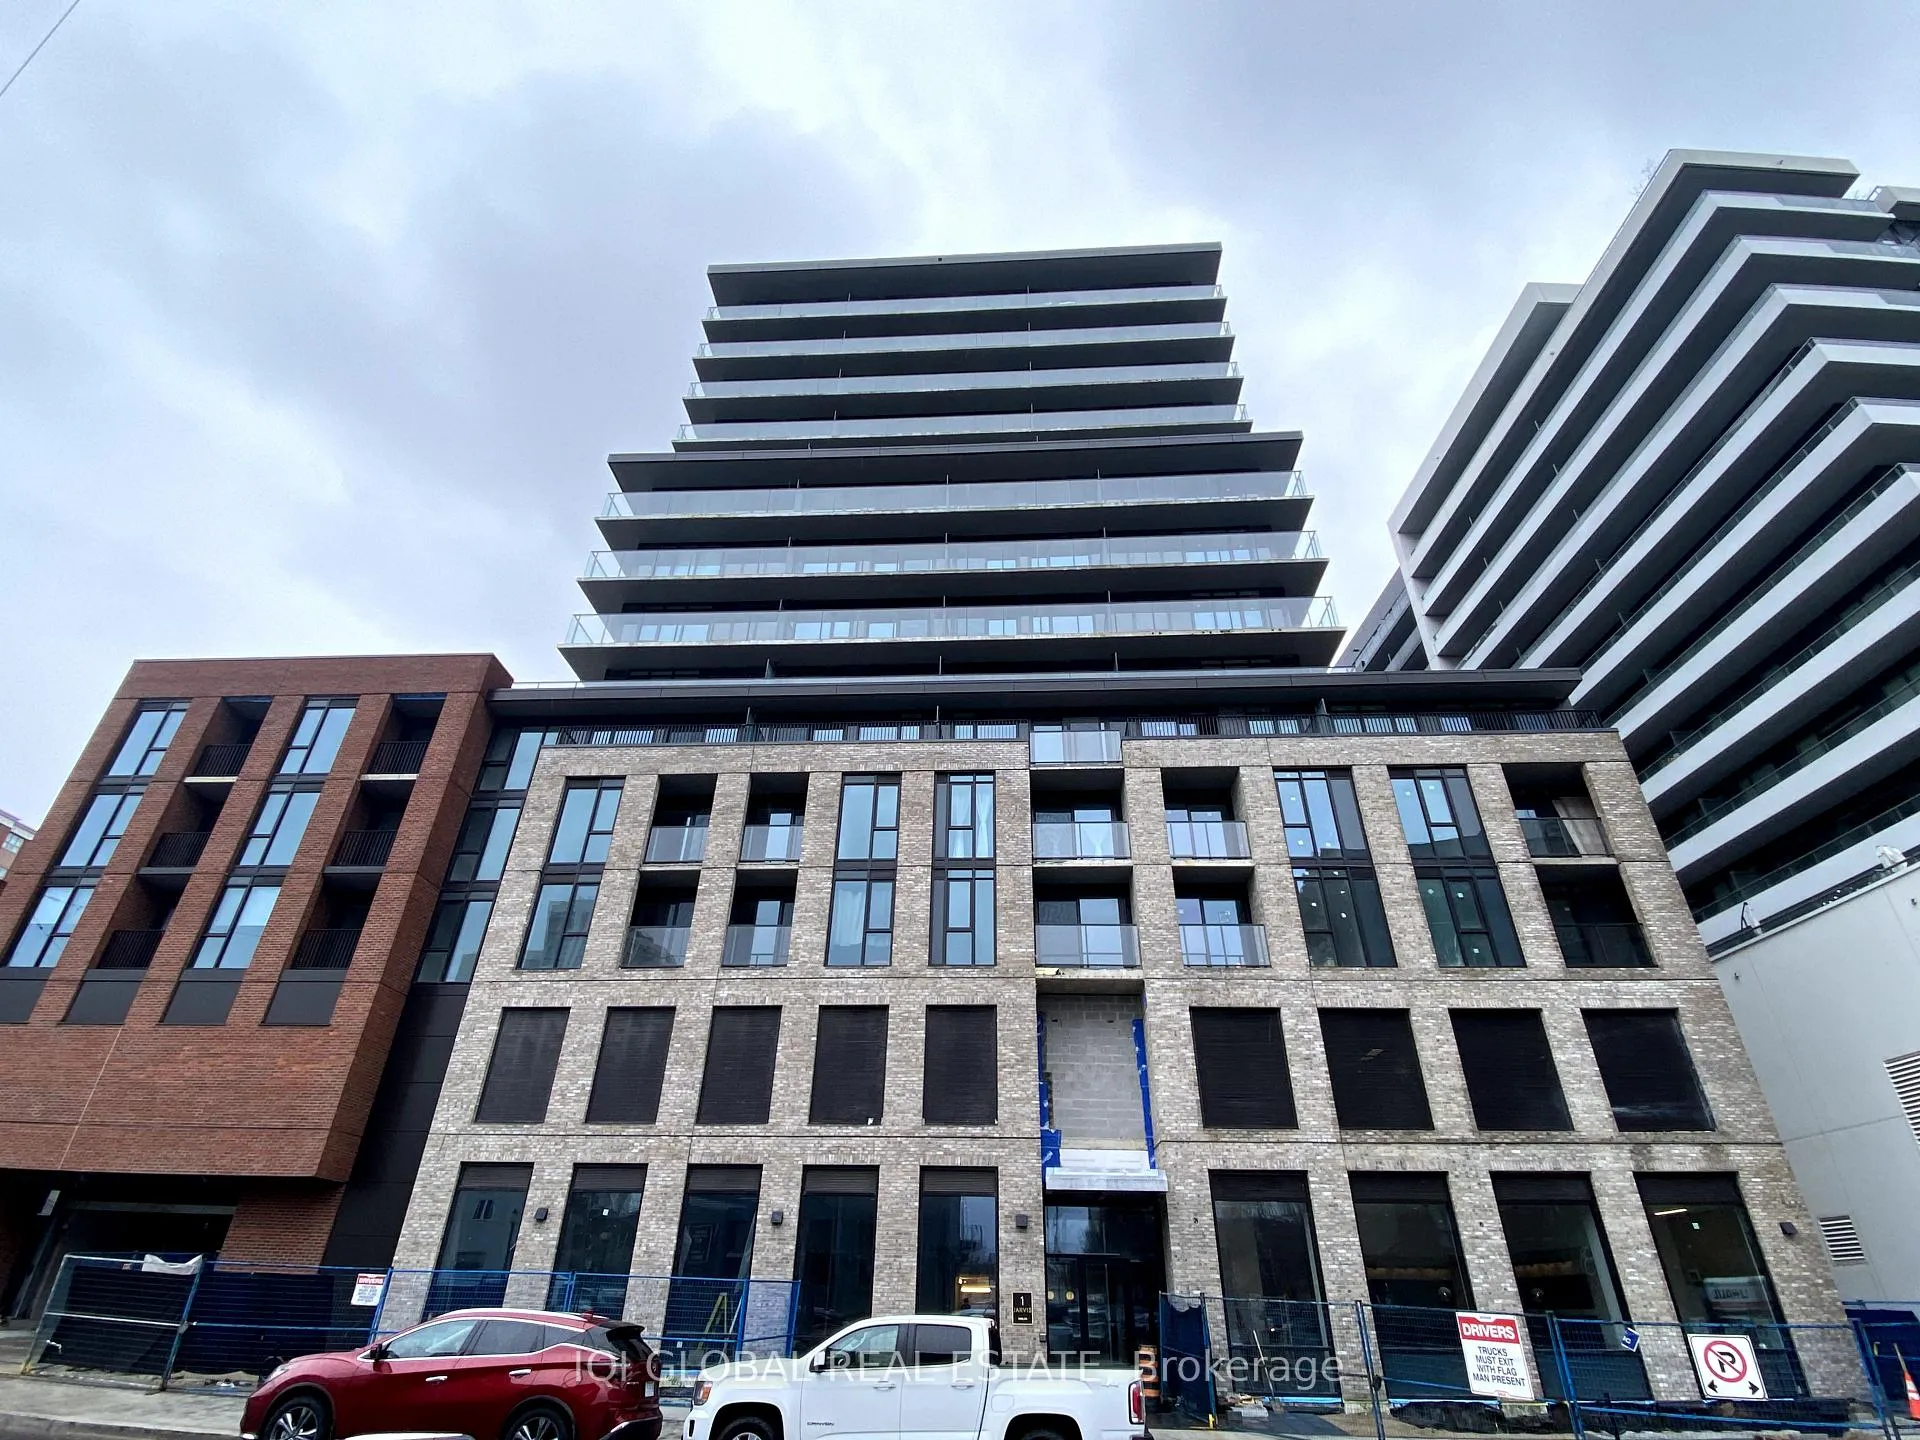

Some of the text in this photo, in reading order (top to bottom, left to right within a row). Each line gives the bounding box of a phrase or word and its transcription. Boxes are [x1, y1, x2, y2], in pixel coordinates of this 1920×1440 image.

[1020, 1295, 1025, 1306] 1
[1461, 1322, 1516, 1340] DRIVERS
[1478, 1346, 1508, 1357] TRUCKS
[1475, 1355, 1514, 1366] MUST EXIT
[1477, 1364, 1517, 1376] WITH FLAG
[1472, 1373, 1526, 1386] MAN PRESENT
